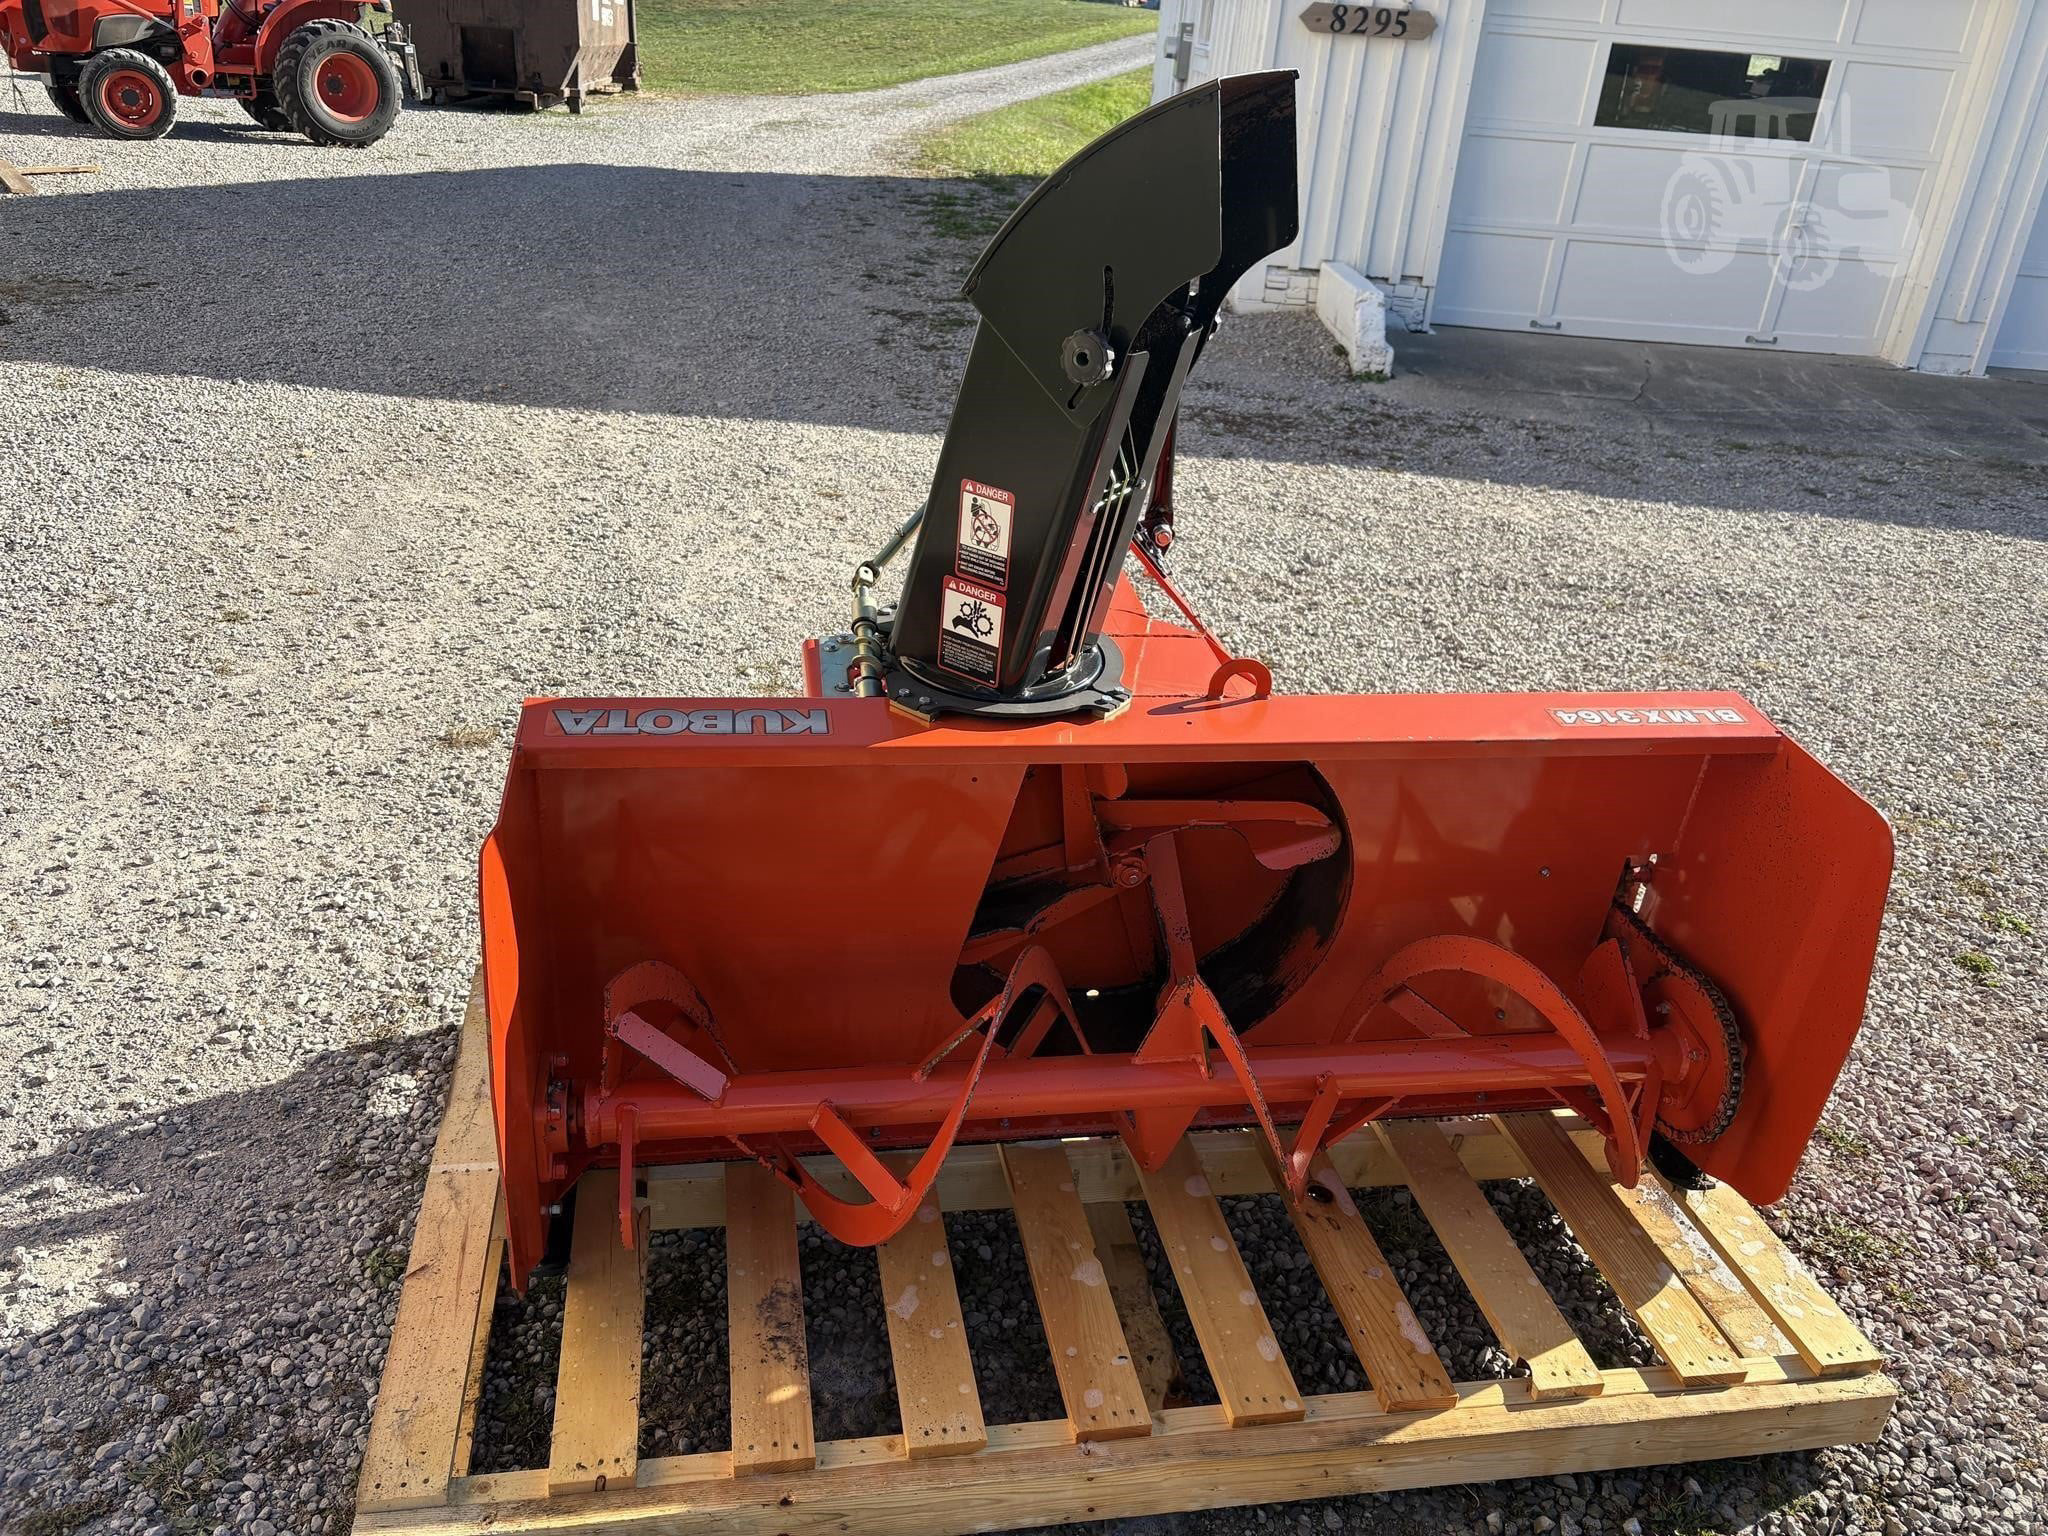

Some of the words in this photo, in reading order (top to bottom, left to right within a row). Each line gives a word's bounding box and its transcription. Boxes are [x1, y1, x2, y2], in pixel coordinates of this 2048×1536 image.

[1329, 4, 1410, 37] 8295
[976, 484, 1009, 502] DANGER
[959, 582, 997, 603] DANGER
[551, 708, 830, 735] KUBOTA
